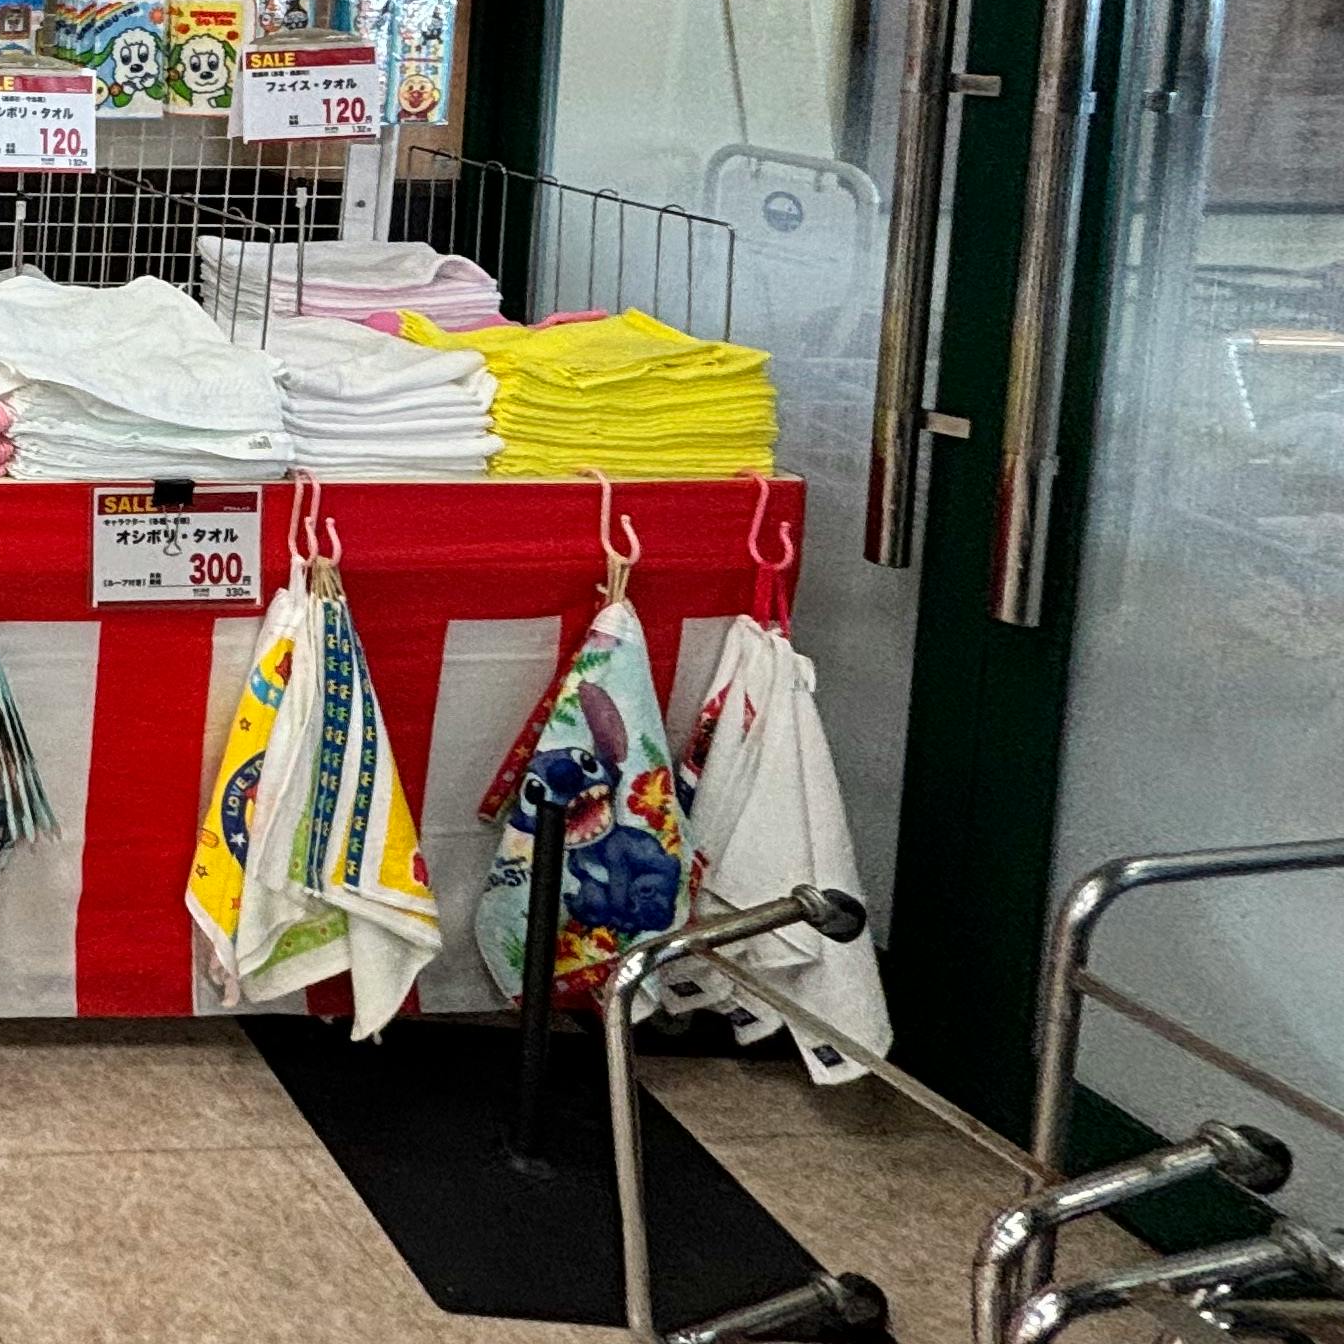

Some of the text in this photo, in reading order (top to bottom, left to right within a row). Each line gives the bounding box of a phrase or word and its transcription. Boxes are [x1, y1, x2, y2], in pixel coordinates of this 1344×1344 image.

[250, 53, 296, 68] SALE
[266, 78, 358, 92] フェイス・タオル
[104, 496, 158, 513] SALE
[116, 528, 239, 545] オシボリ・タオル
[226, 776, 248, 817] LOVE
